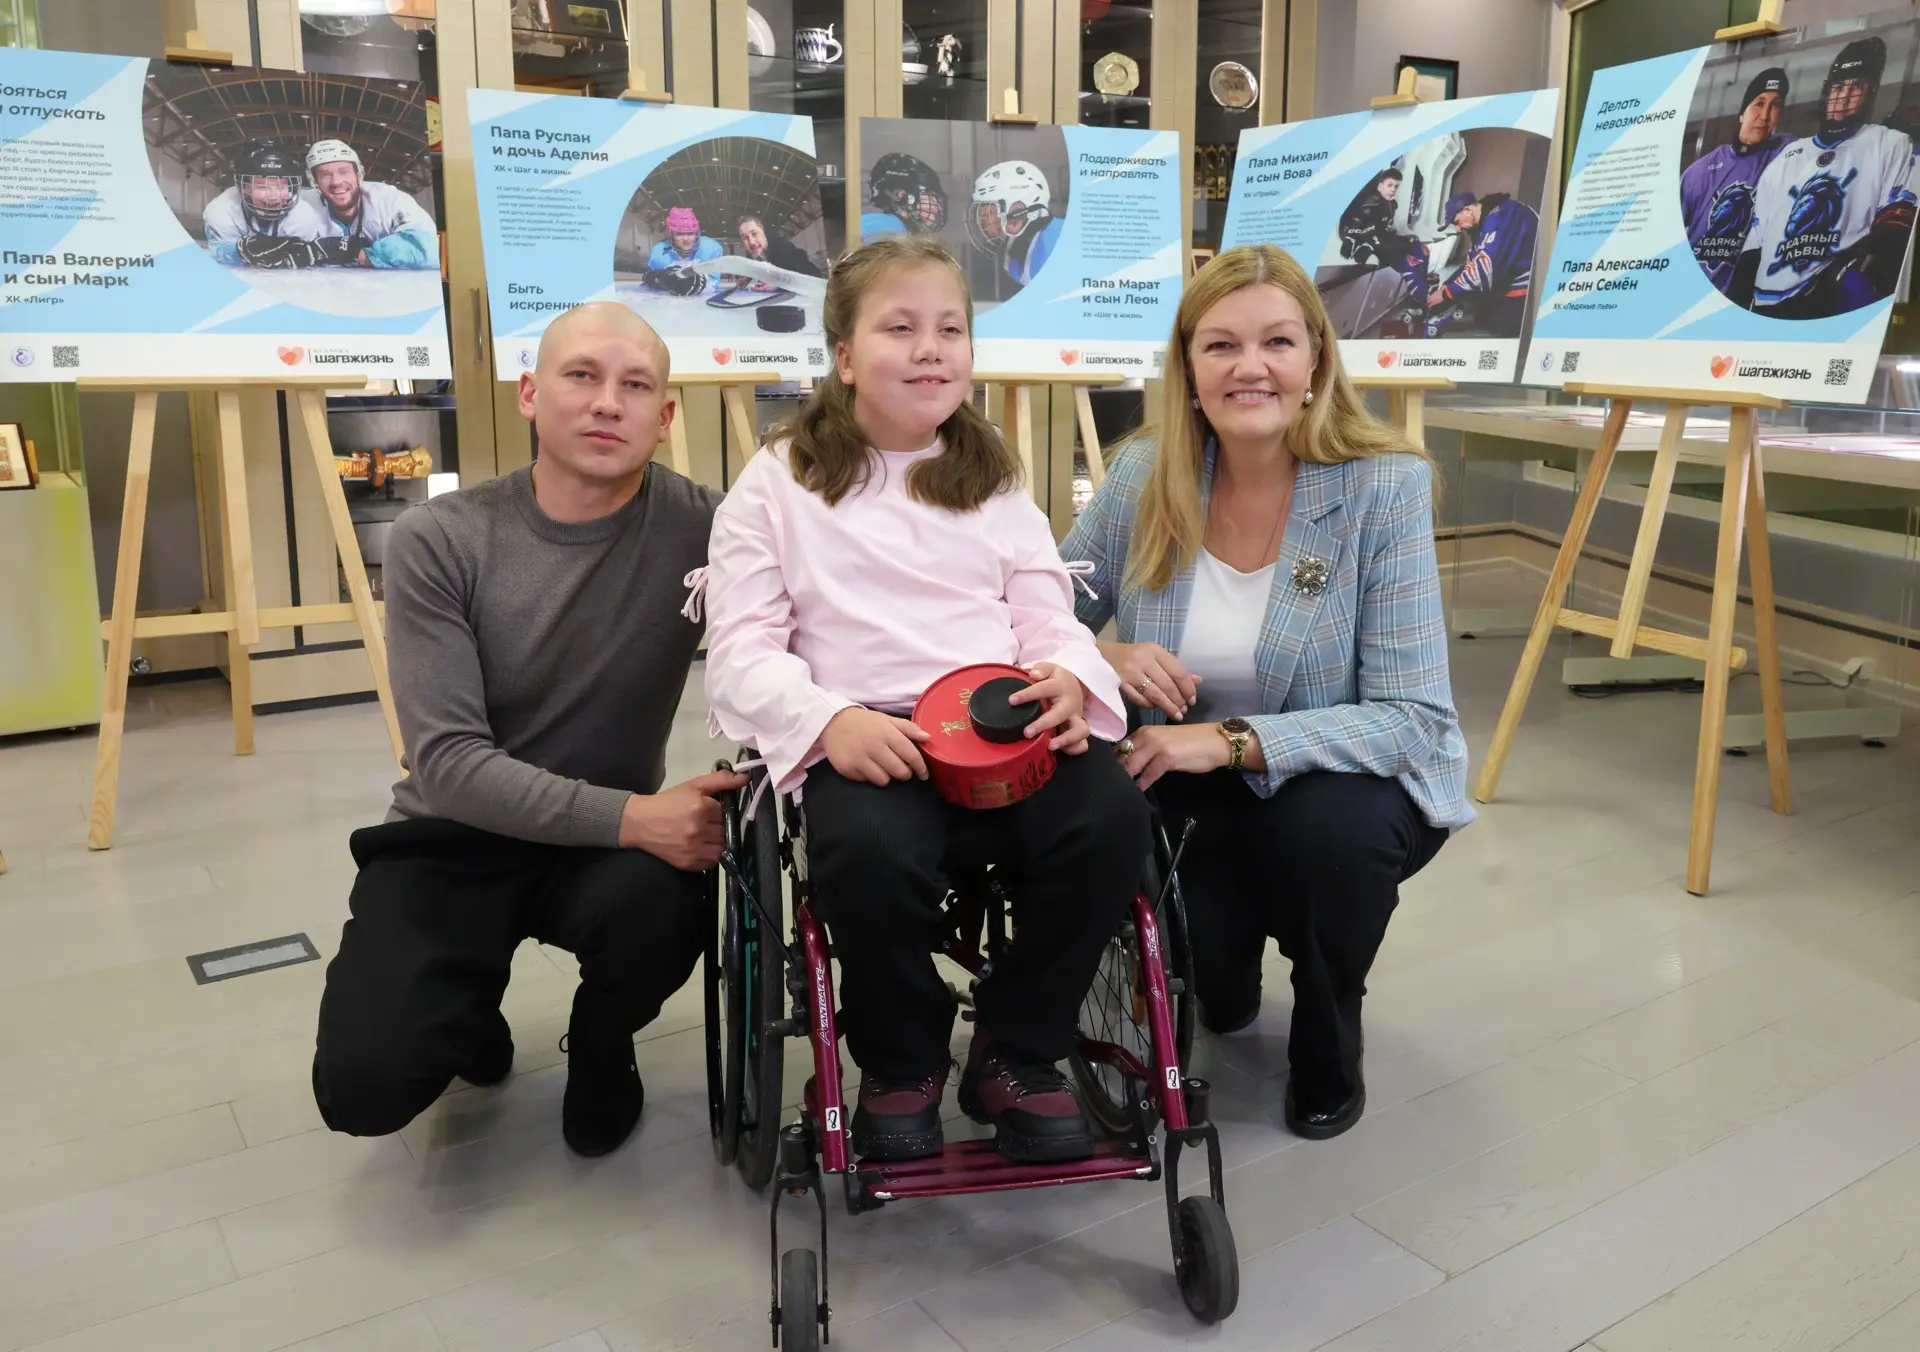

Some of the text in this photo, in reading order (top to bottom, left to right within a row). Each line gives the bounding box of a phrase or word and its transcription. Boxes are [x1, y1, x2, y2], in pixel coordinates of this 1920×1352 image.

[9, 105, 105, 120] отпускать
[1597, 98, 1641, 116] Делать
[1594, 109, 1677, 131] невозможное
[491, 125, 591, 144] Папа Руслан
[492, 146, 609, 161] и дочь Аделия
[1079, 153, 1167, 166] Поддерживать
[1248, 151, 1329, 169] Папа Михаил
[1090, 169, 1159, 180] направлять
[1245, 169, 1312, 184] и сын Вова
[1778, 234, 1840, 254] ЛЕДЯНЫЕ
[3, 251, 155, 269] Папа Валерий
[1785, 246, 1825, 262] ЛЬВЫ
[1562, 258, 1670, 273] Папа Александр
[4, 272, 130, 288] и сын Марк
[1082, 278, 1160, 291] Папа Марат
[1557, 276, 1639, 292] и сын Семён
[508, 283, 544, 295] Быть
[5, 295, 21, 303] ХК
[509, 301, 584, 312] искренни
[1082, 294, 1159, 305] и сын Леон
[315, 354, 394, 364] шагвжизнь
[740, 355, 798, 363] шагвжизнь
[1086, 356, 1143, 365] шагвжизнь
[1403, 358, 1467, 367] шагвжизнь
[1738, 366, 1812, 380] шагвжизнь
